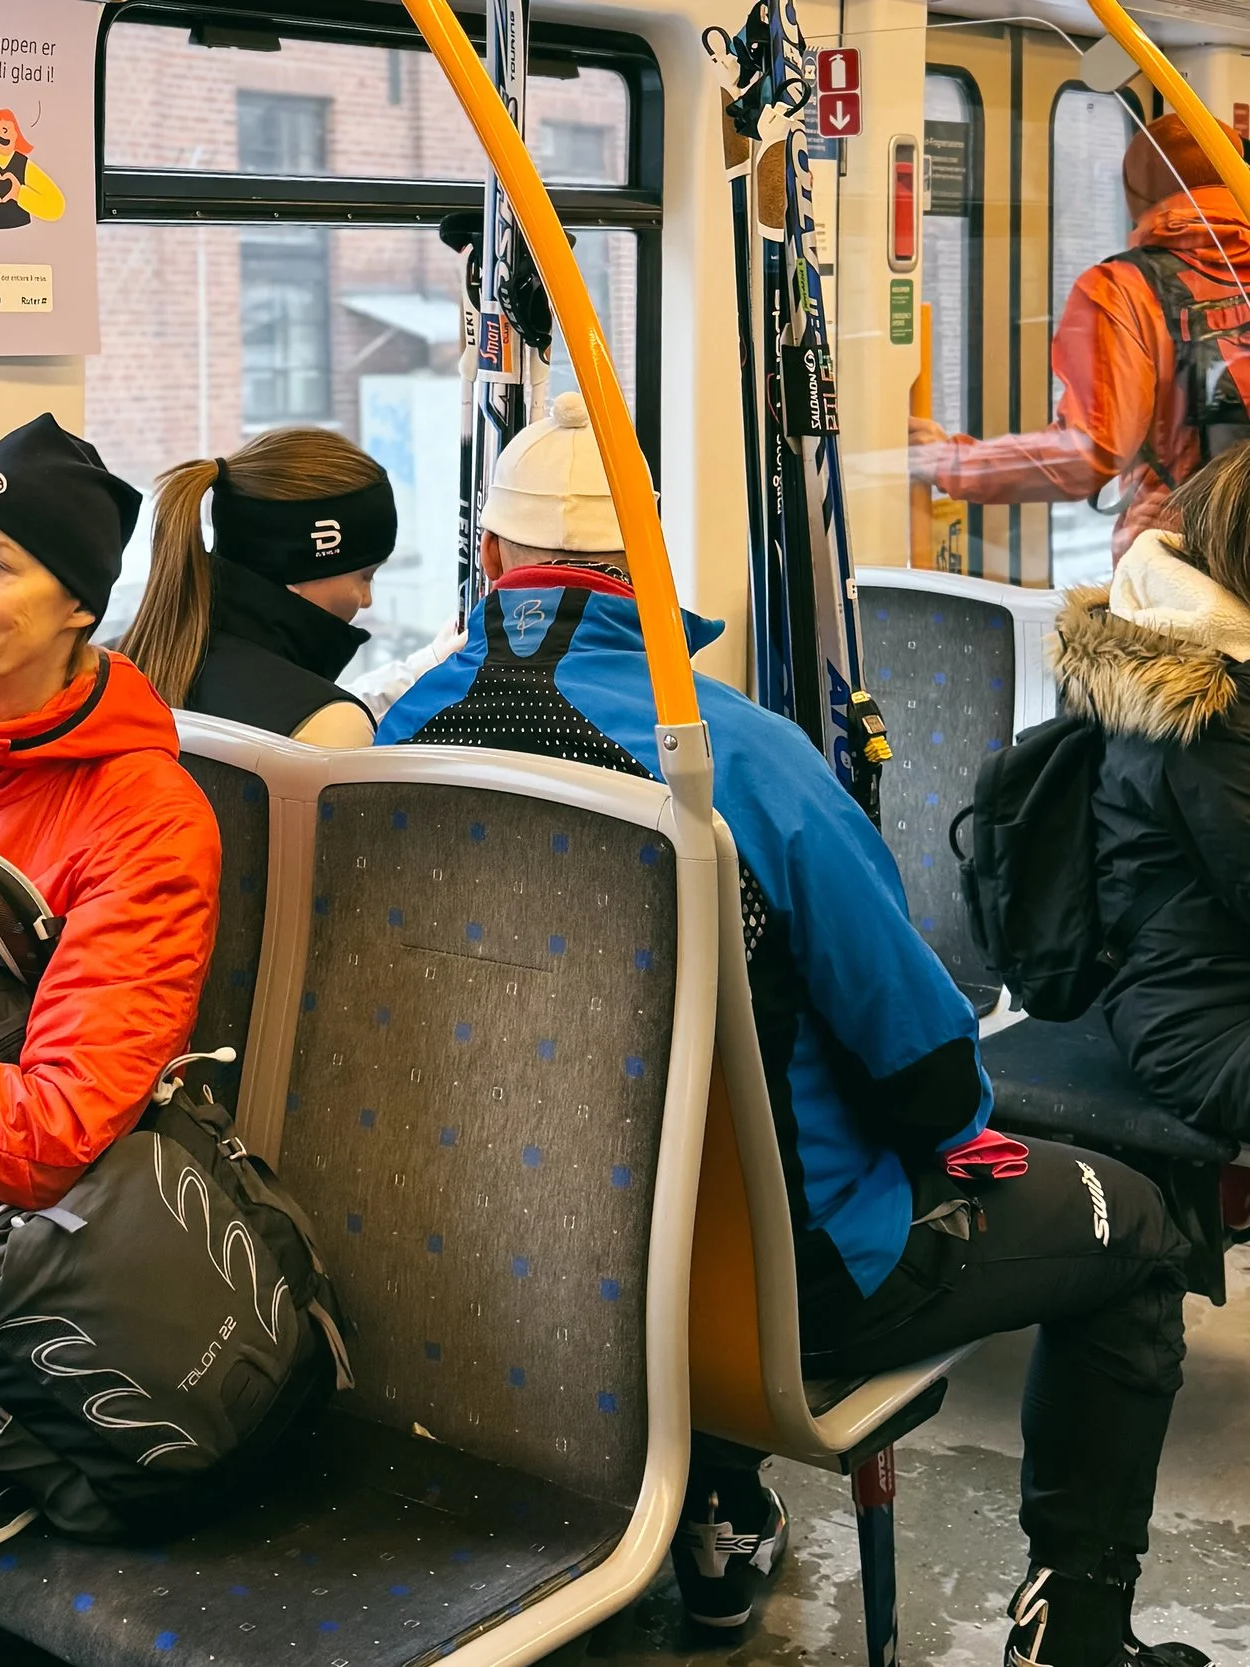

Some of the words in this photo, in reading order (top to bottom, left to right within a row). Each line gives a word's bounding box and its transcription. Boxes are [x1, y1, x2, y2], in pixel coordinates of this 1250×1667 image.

[42, 42, 56, 56] er
[11, 64, 42, 84] glad
[47, 66, 54, 83] i!
[465, 311, 476, 346] LEKI
[480, 321, 500, 364] Smart
[808, 373, 822, 430] SALOMON
[458, 499, 470, 566] LEKI
[176, 1341, 222, 1392] TALON
[218, 1315, 237, 1341] 22
